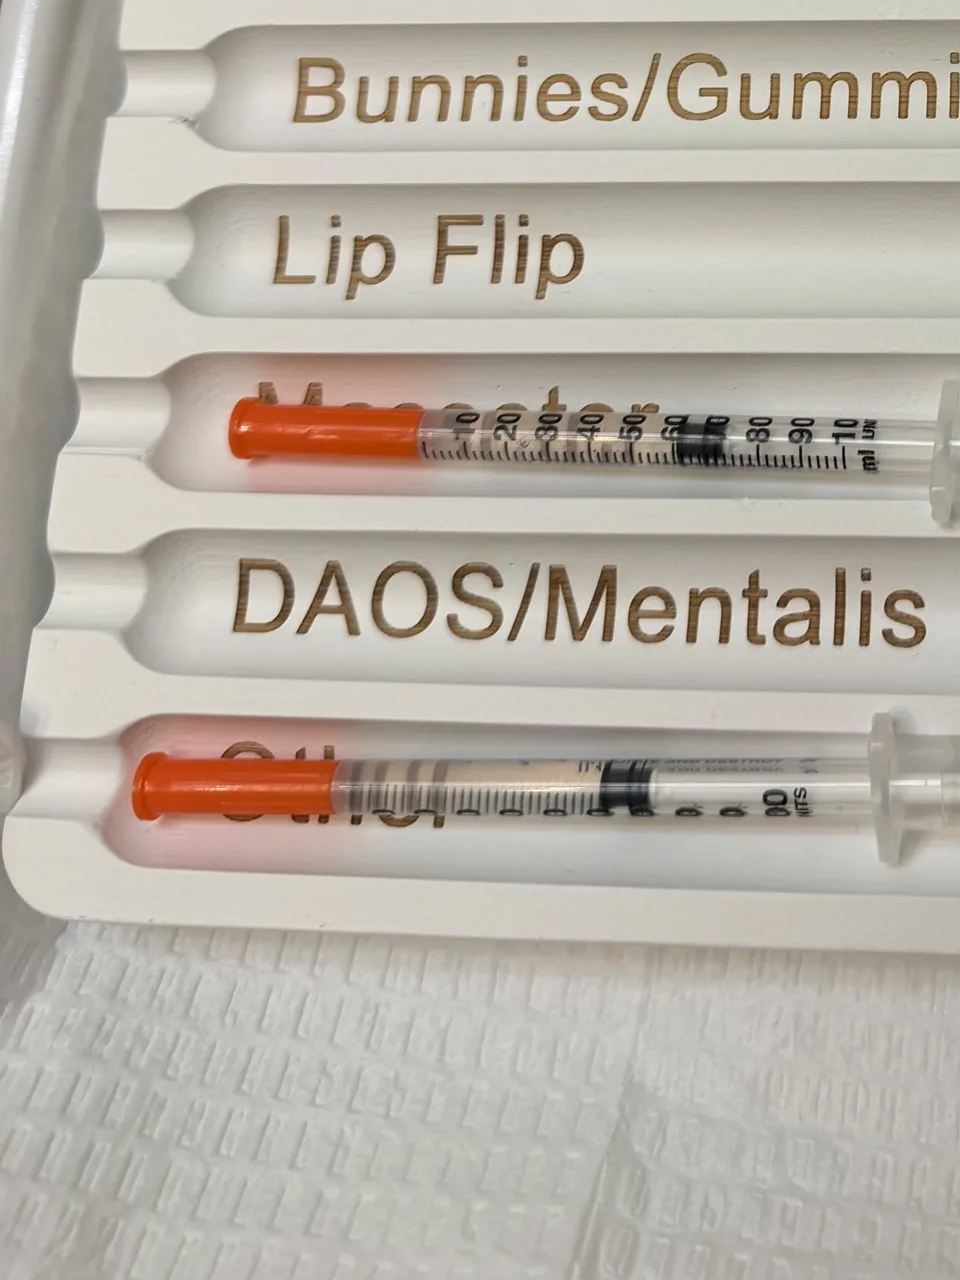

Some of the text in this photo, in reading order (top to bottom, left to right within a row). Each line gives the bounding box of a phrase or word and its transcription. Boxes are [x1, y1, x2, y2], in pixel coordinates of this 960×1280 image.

[271, 211, 586, 301] Lip Flip
[453, 412, 480, 440] 10
[493, 412, 521, 441] 20
[577, 413, 604, 441] 40
[618, 414, 647, 441] 50
[745, 416, 773, 444] 80
[788, 417, 815, 444] 90
[231, 556, 928, 649] DAOS/Mentalis
